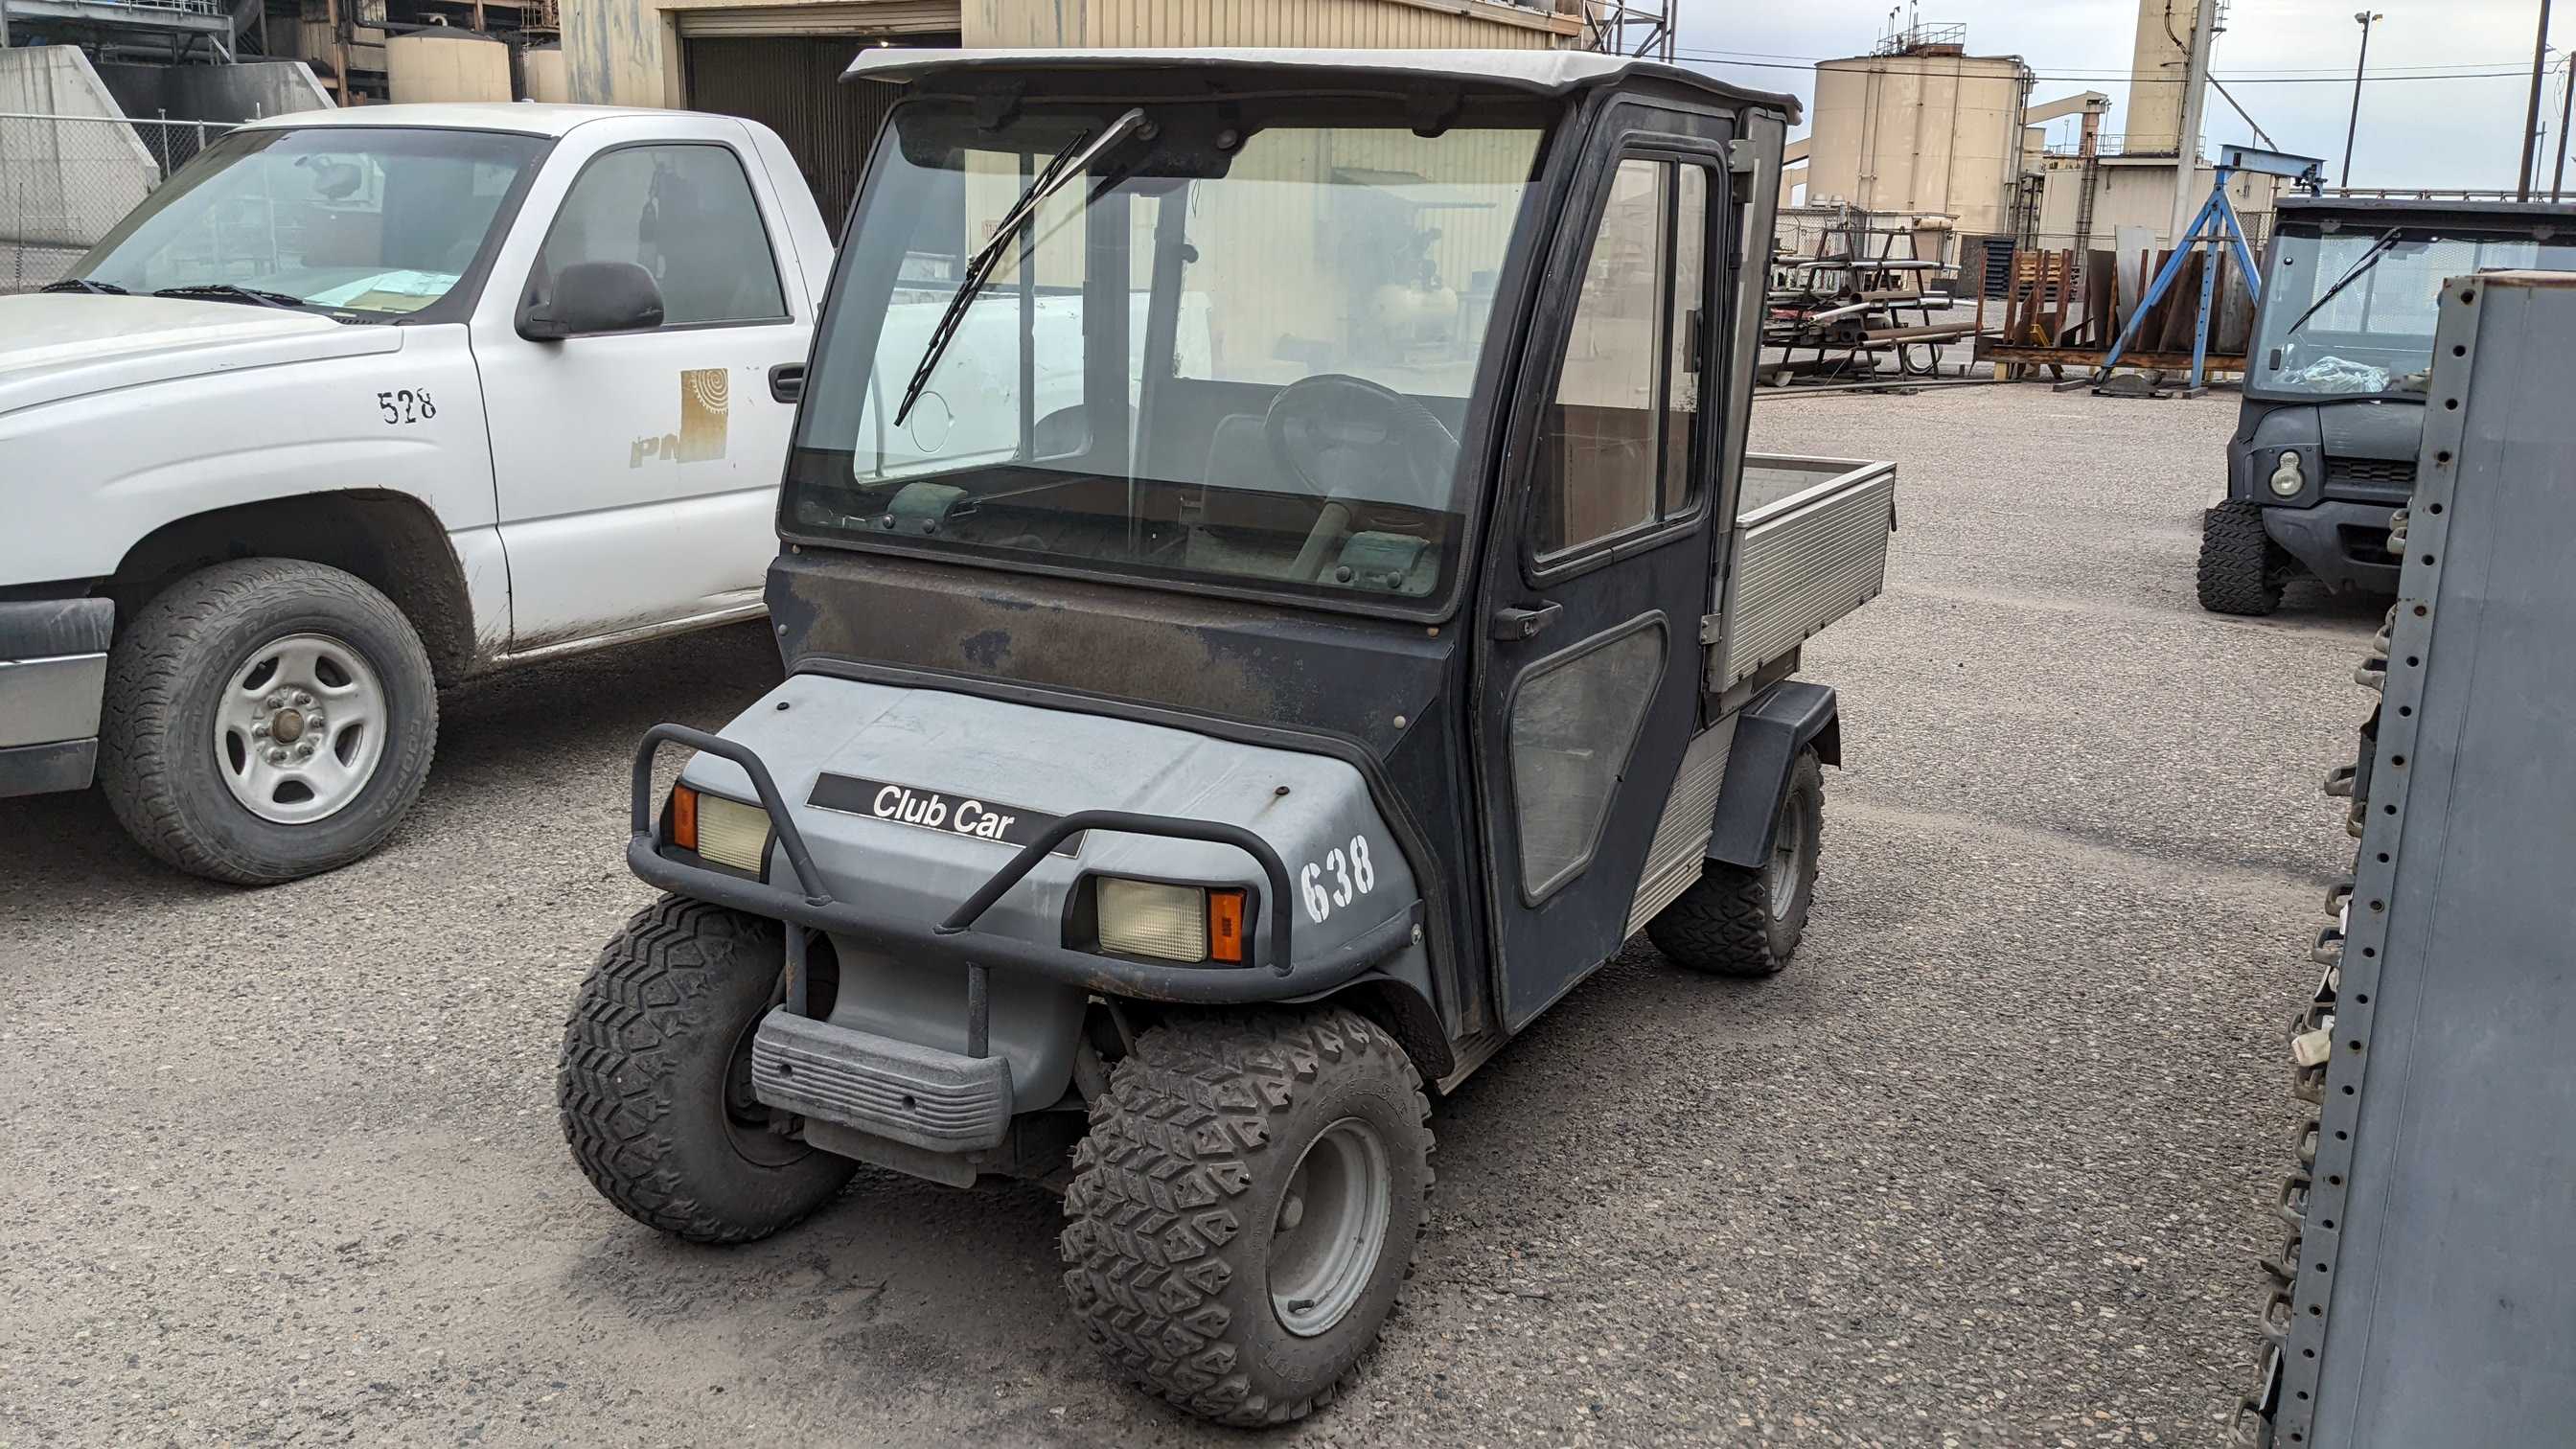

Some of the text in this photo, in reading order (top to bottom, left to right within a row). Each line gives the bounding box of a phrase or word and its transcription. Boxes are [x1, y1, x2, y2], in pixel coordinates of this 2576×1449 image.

[377, 387, 436, 425] 528
[873, 785, 1015, 840] Club Car
[1301, 835, 1374, 923] 638
